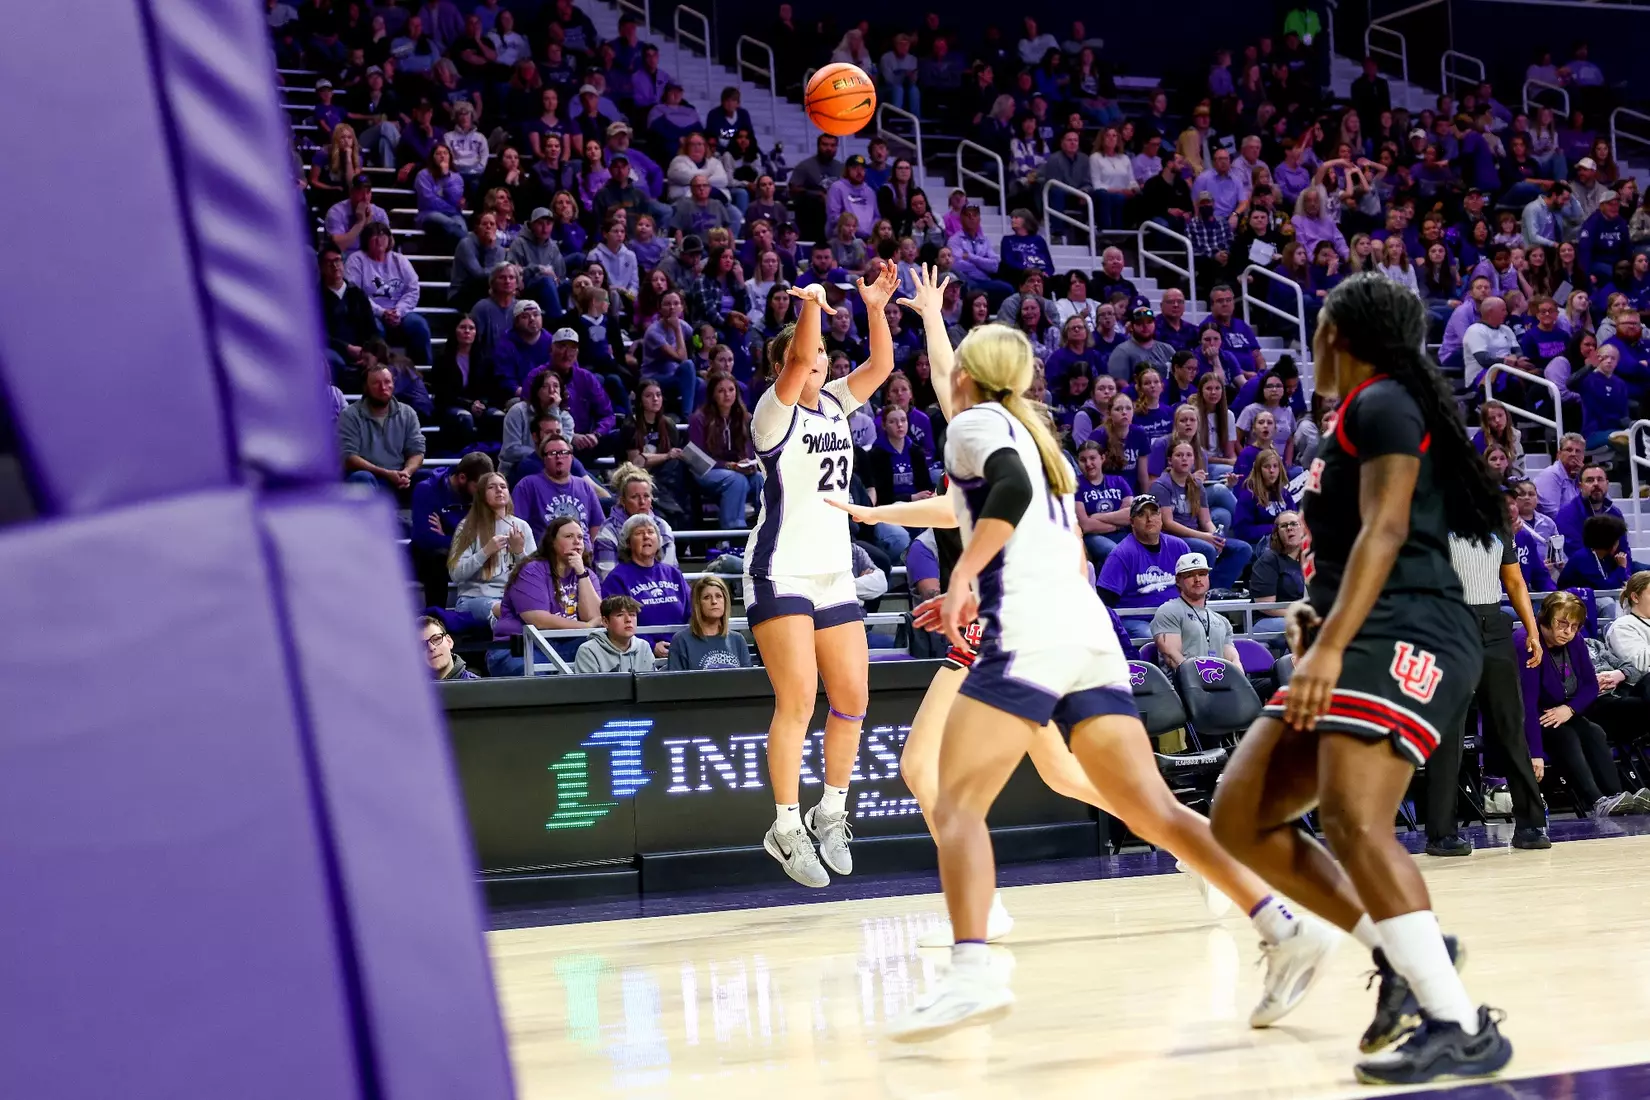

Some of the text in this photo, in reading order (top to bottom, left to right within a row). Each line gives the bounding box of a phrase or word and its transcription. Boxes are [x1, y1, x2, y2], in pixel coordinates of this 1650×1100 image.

[802, 431, 851, 454] Wildca
[817, 456, 848, 492] 23
[630, 581, 658, 596] KANSAS
[641, 596, 678, 604] WILDCATS
[1559, 776, 1567, 785] 5
[1628, 771, 1637, 779] 6
